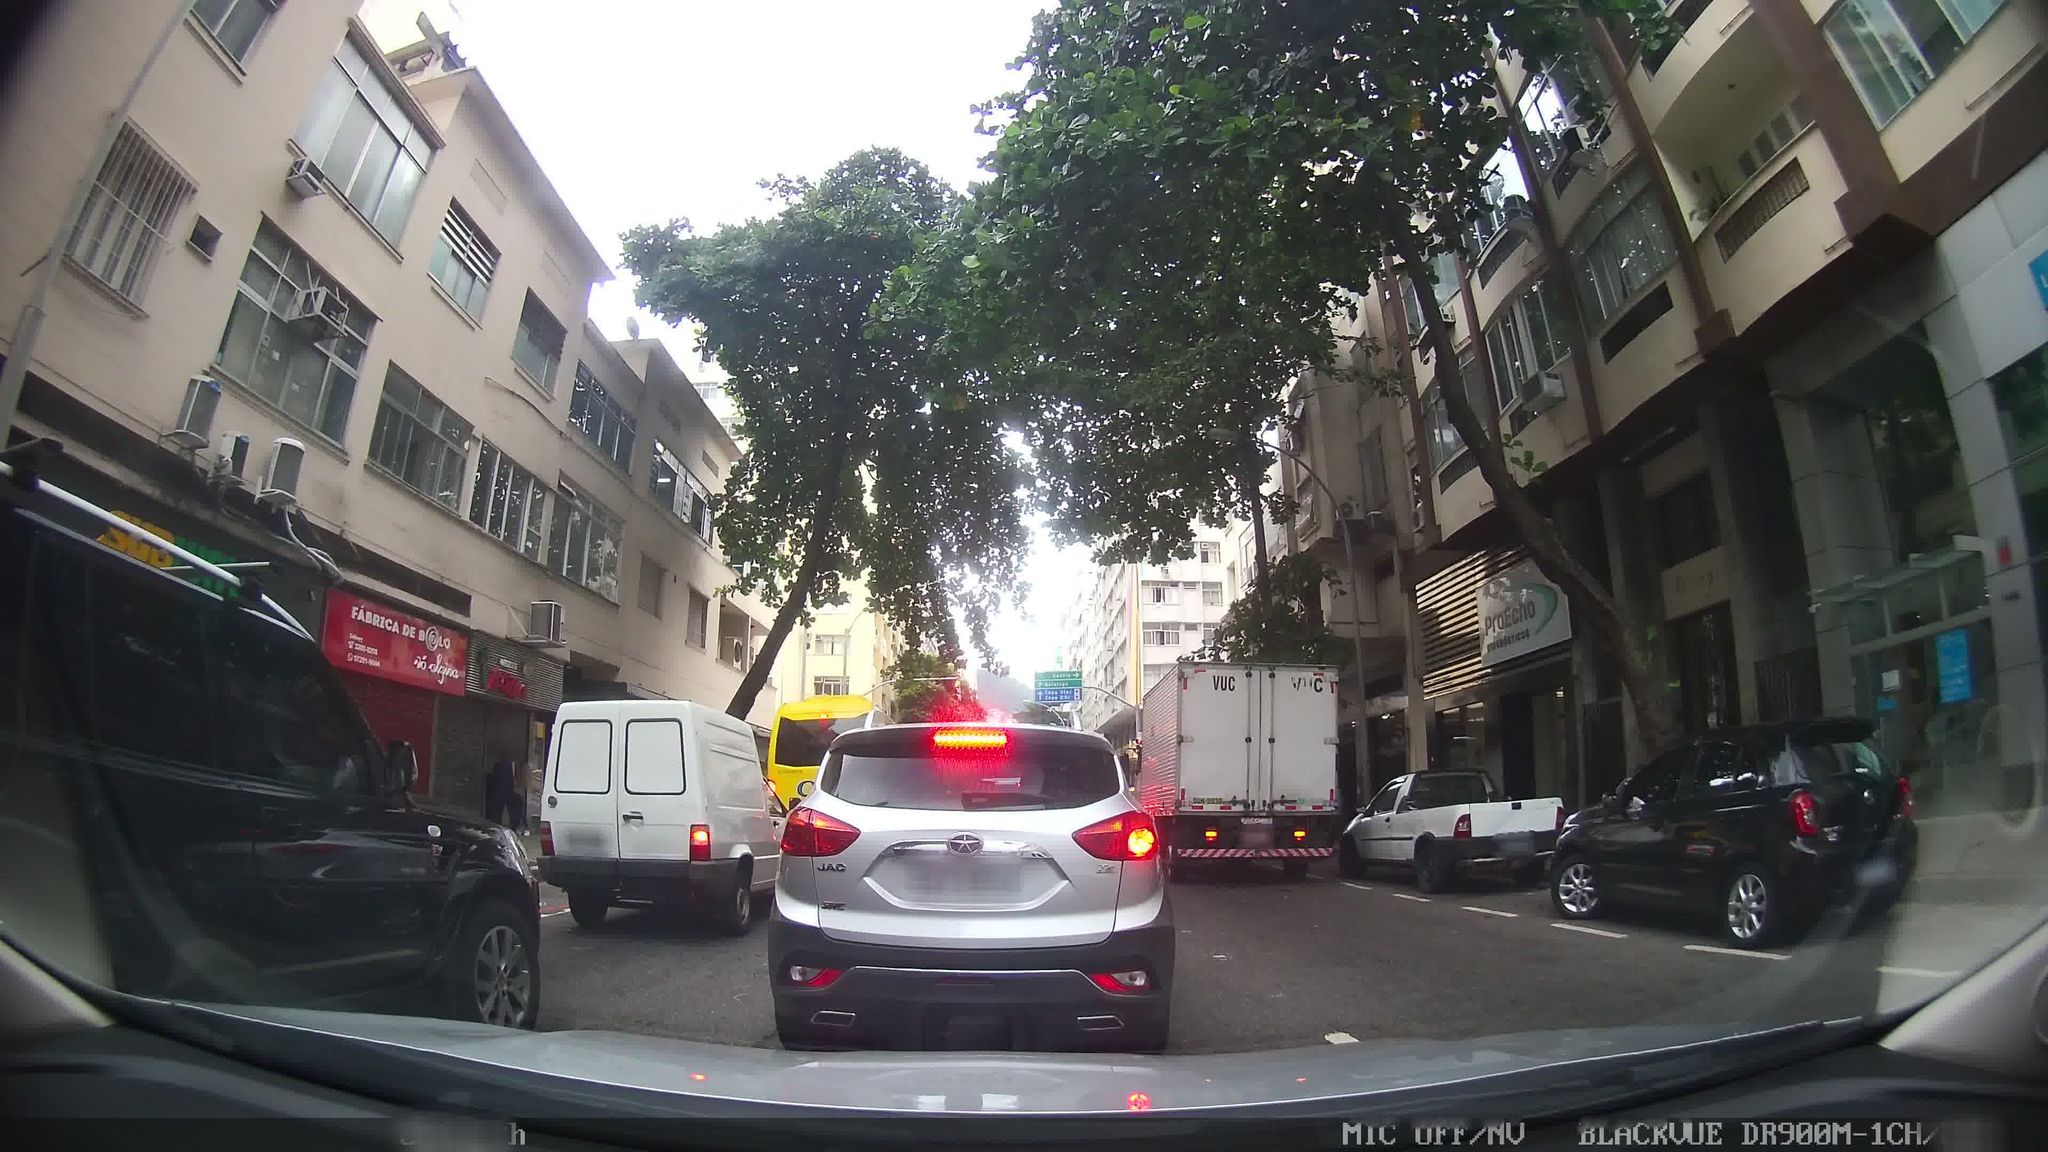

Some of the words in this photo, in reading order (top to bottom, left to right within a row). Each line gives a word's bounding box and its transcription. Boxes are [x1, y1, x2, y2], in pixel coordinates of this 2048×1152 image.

[351, 605, 400, 634] FÁBRICA
[402, 624, 416, 639] DE
[418, 626, 451, 651] BOLO
[1212, 675, 1236, 692] VUC
[817, 863, 847, 872] JAC
